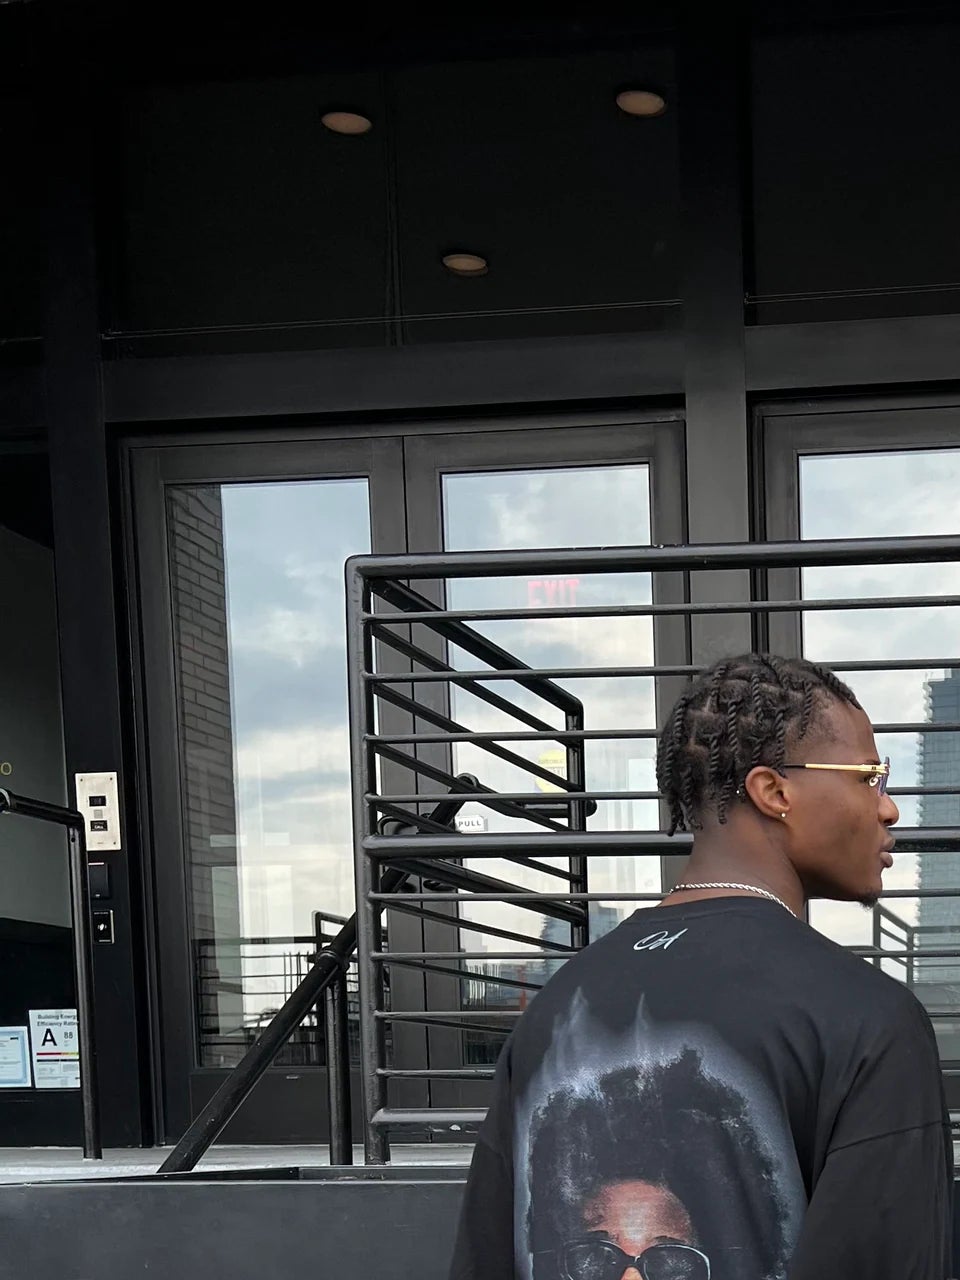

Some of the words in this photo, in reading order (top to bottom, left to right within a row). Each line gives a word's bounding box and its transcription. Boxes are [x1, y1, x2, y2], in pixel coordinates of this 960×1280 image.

[528, 579, 580, 608] EXIT
[458, 819, 482, 827] PULL
[41, 1028, 58, 1046] A
[63, 1031, 74, 1039] 88
